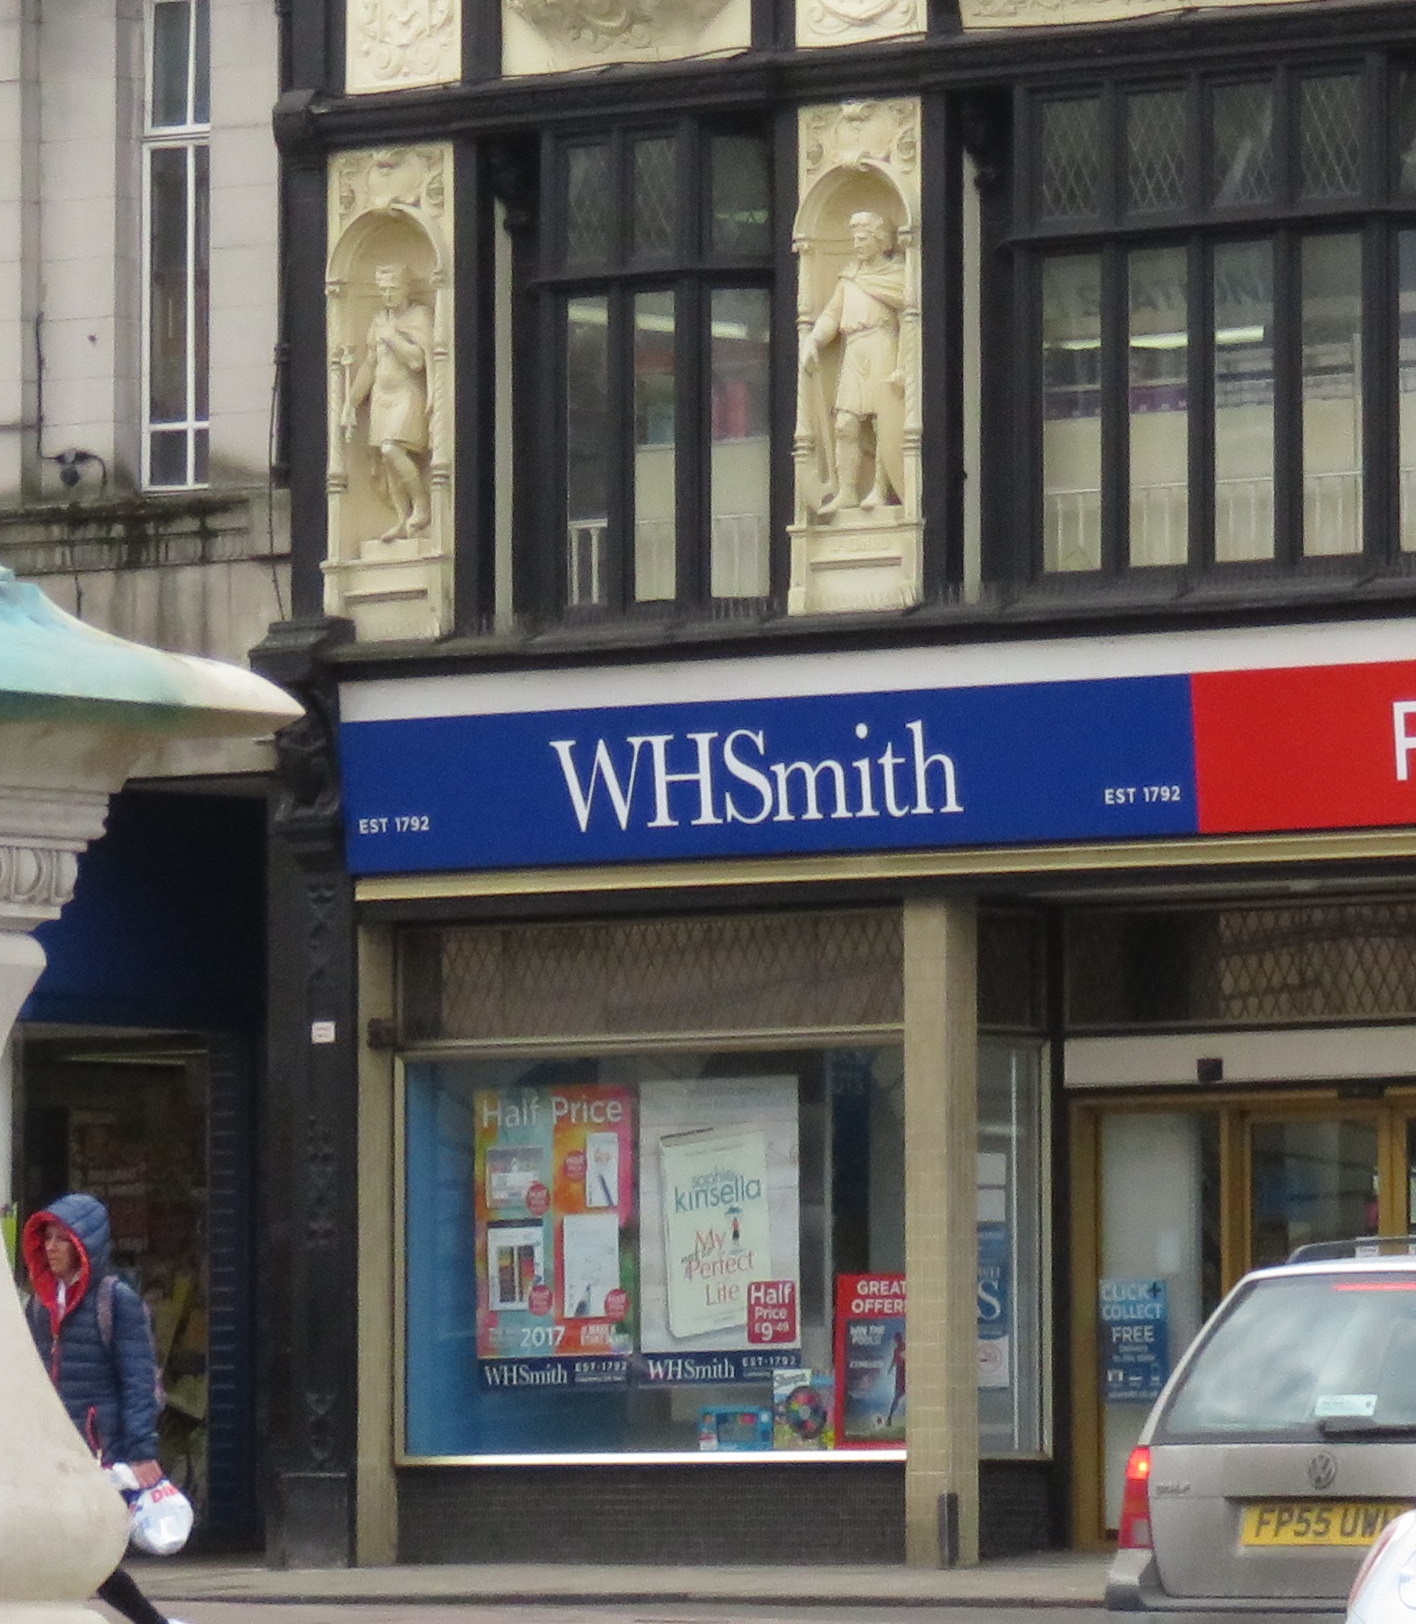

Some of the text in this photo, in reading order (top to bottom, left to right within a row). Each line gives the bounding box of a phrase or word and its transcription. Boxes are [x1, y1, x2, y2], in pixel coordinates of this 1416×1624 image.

[549, 720, 965, 835] WHSmith
[1103, 784, 1183, 806] EST 1792
[357, 813, 431, 835] EST 1792
[481, 1094, 541, 1128] Half
[550, 1094, 623, 1126] Price
[674, 1175, 762, 1214] kinsella
[750, 1282, 793, 1306] Half
[754, 1306, 788, 1320] Price
[850, 1298, 907, 1314] OFFER
[1102, 1302, 1163, 1322] COLLECT
[520, 1325, 566, 1348] 2017
[1112, 1324, 1155, 1343] FREE
[483, 1362, 569, 1387] WHSmith
[647, 1357, 737, 1381] WHSmith
[1255, 1504, 1392, 1539] FP55 UW
